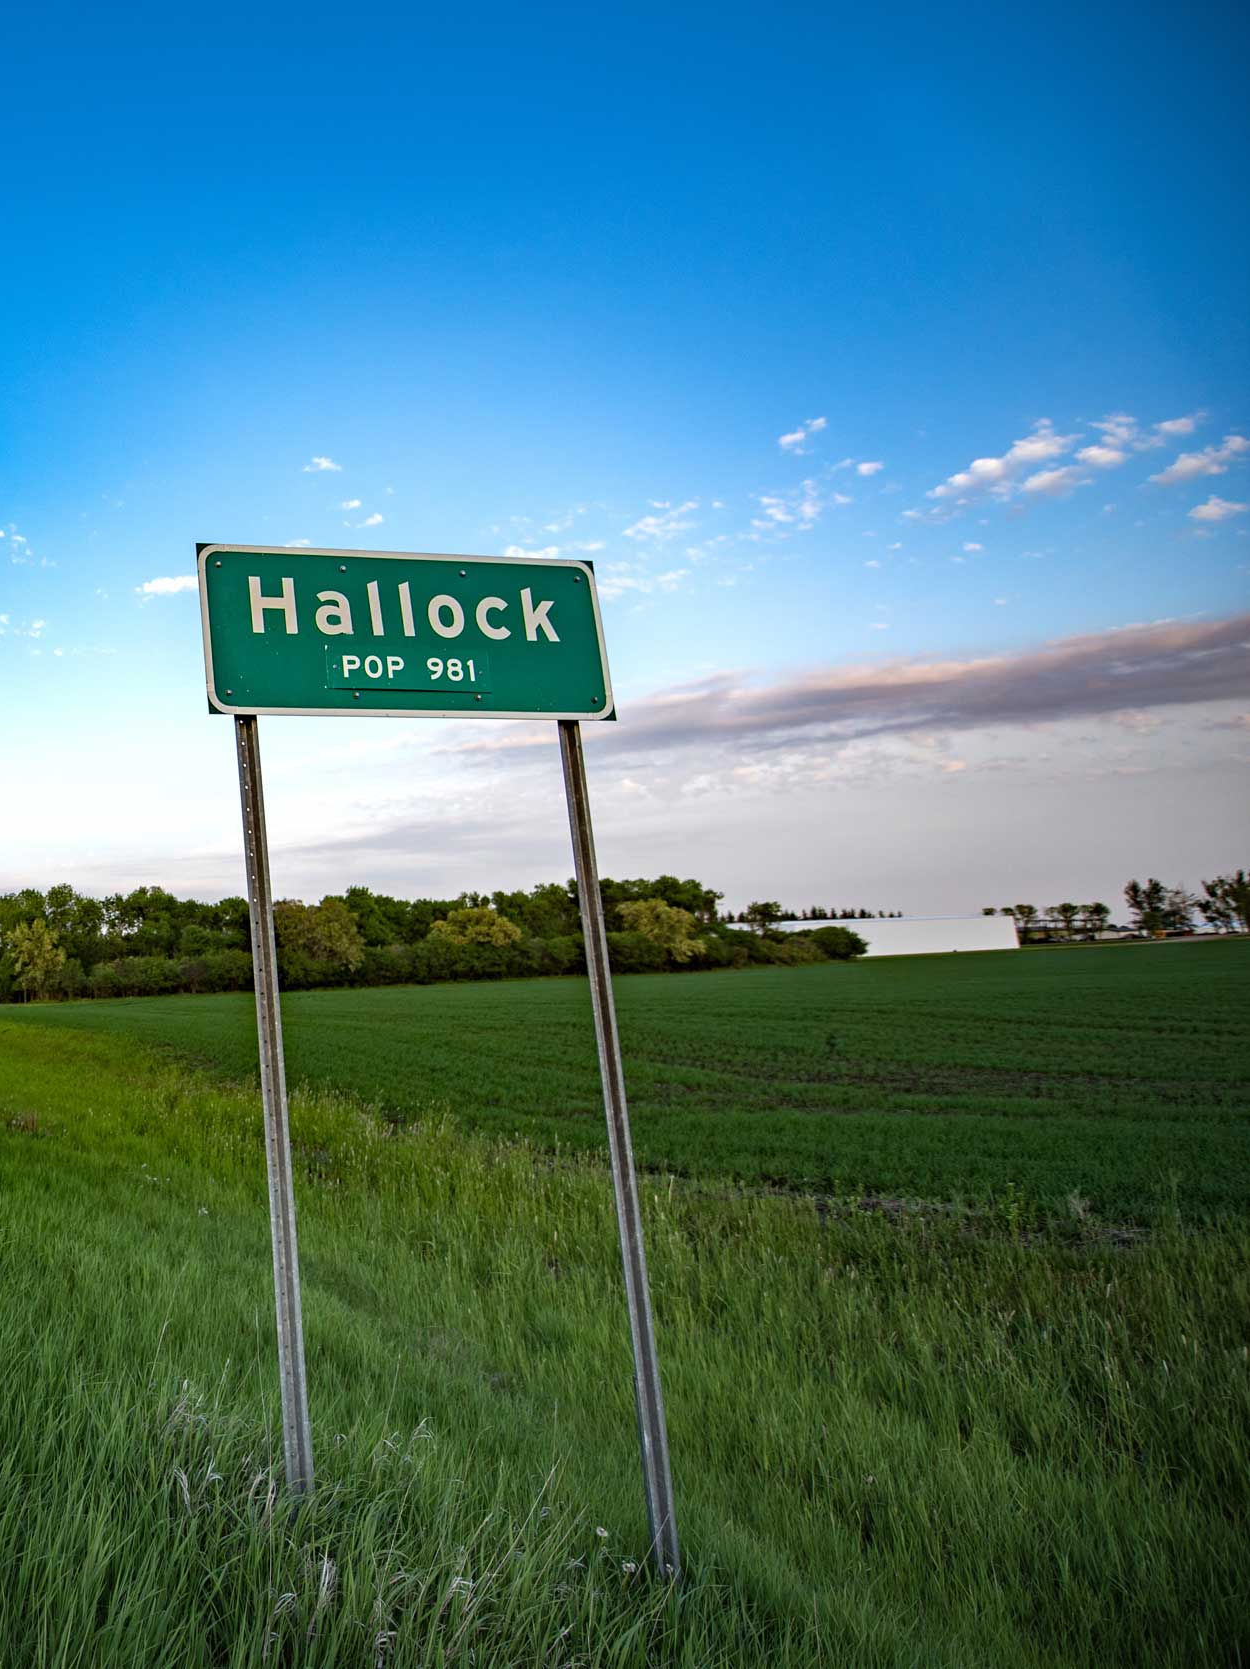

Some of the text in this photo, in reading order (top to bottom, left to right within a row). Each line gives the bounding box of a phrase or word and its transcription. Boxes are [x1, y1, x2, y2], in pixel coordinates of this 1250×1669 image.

[248, 576, 561, 643] Hallock
[341, 655, 477, 682] POP 981
